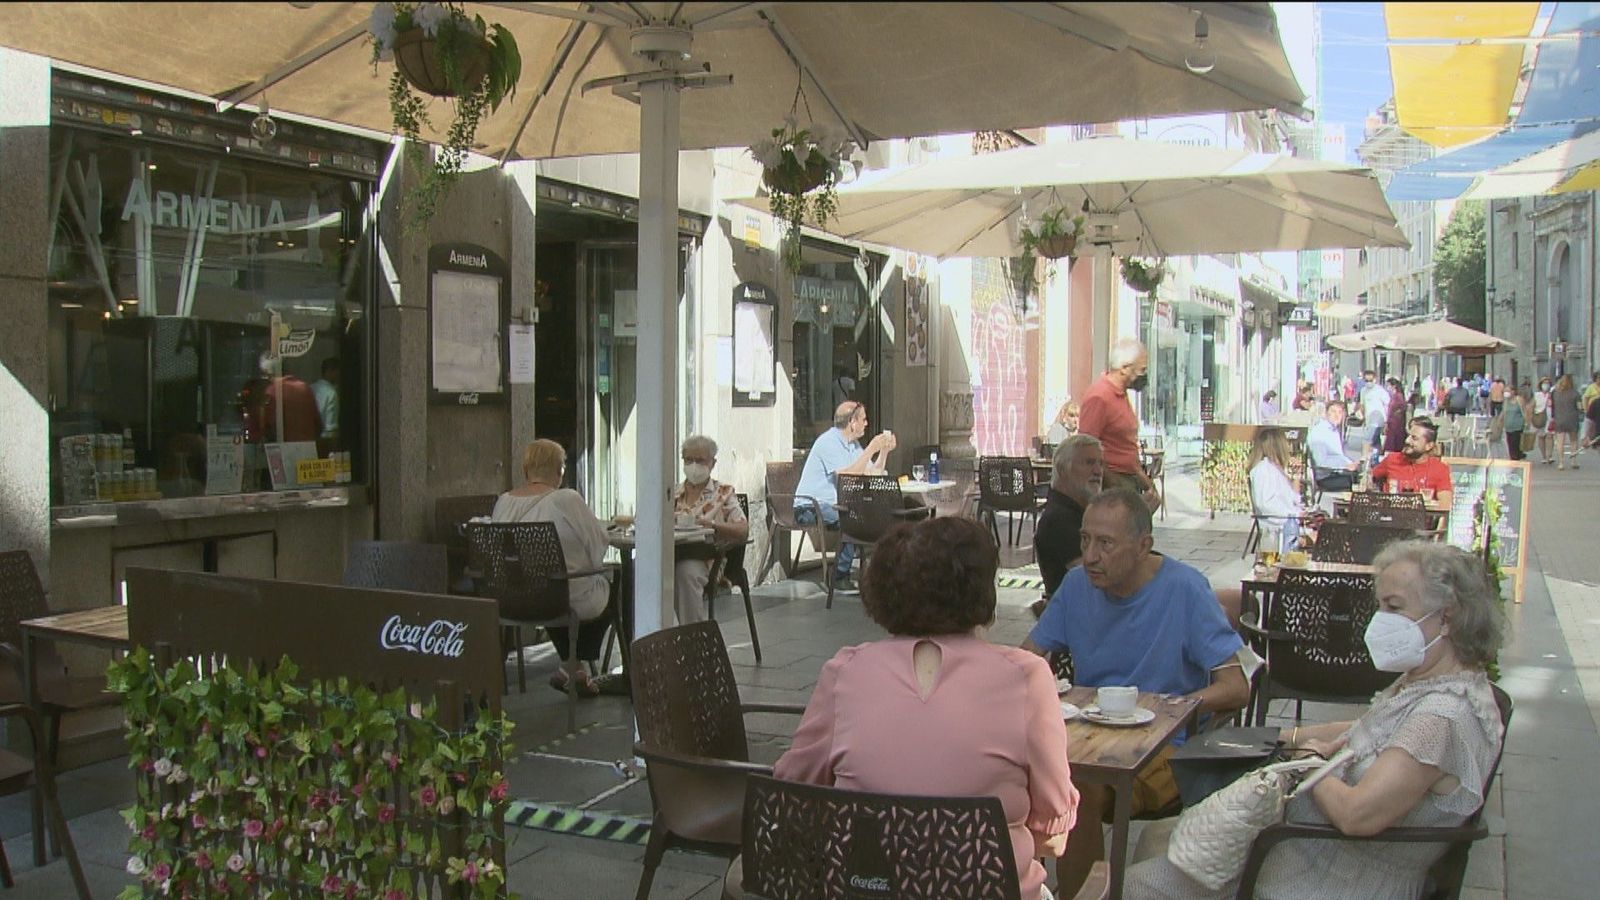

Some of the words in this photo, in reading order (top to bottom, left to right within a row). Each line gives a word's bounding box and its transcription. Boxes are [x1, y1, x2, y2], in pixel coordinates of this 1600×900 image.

[121, 178, 289, 241] ARMENIA
[449, 249, 488, 269] ARMENIA
[380, 614, 469, 658] Coca-Cola
